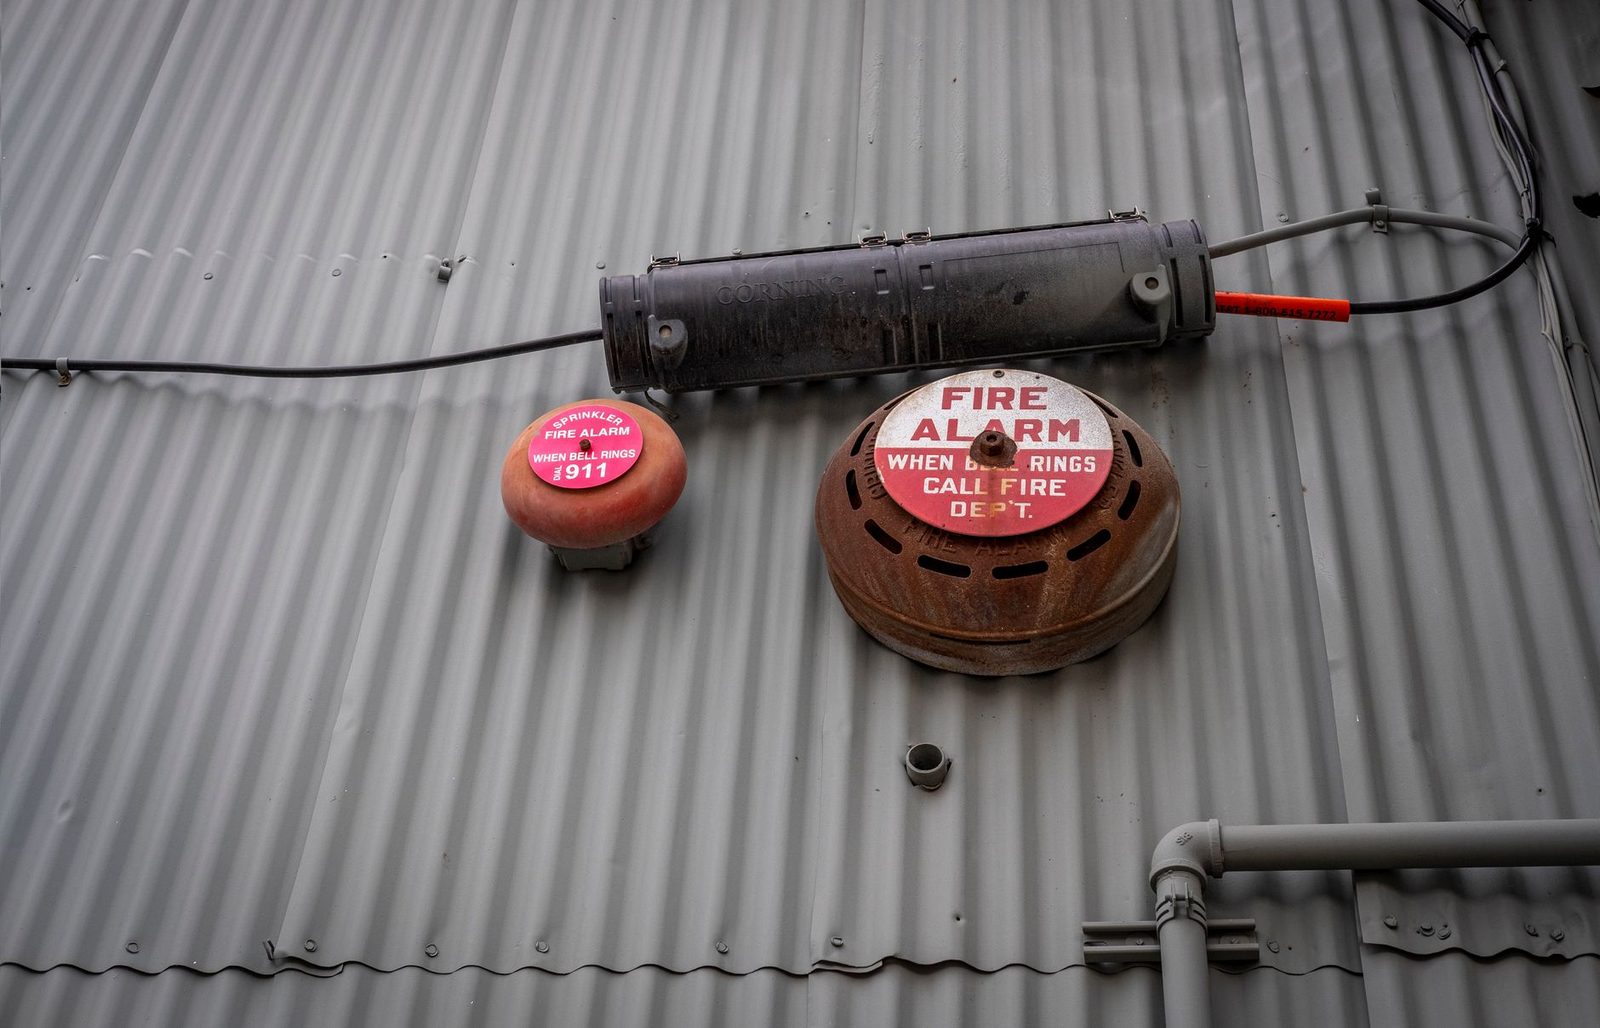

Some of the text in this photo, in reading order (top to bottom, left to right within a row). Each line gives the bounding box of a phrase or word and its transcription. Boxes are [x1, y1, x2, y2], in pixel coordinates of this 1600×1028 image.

[715, 276, 850, 305] CORNING
[941, 386, 1049, 410] FIRE
[552, 410, 623, 429] SPRINKLER
[544, 426, 630, 440] FIRE ALARM
[533, 449, 636, 463] WHEN BELL RINGS
[887, 453, 954, 471] WHEN
[1029, 455, 1097, 473] RINGS
[553, 462, 607, 481] DIAL 911
[923, 477, 1067, 497] CALL FIRE
